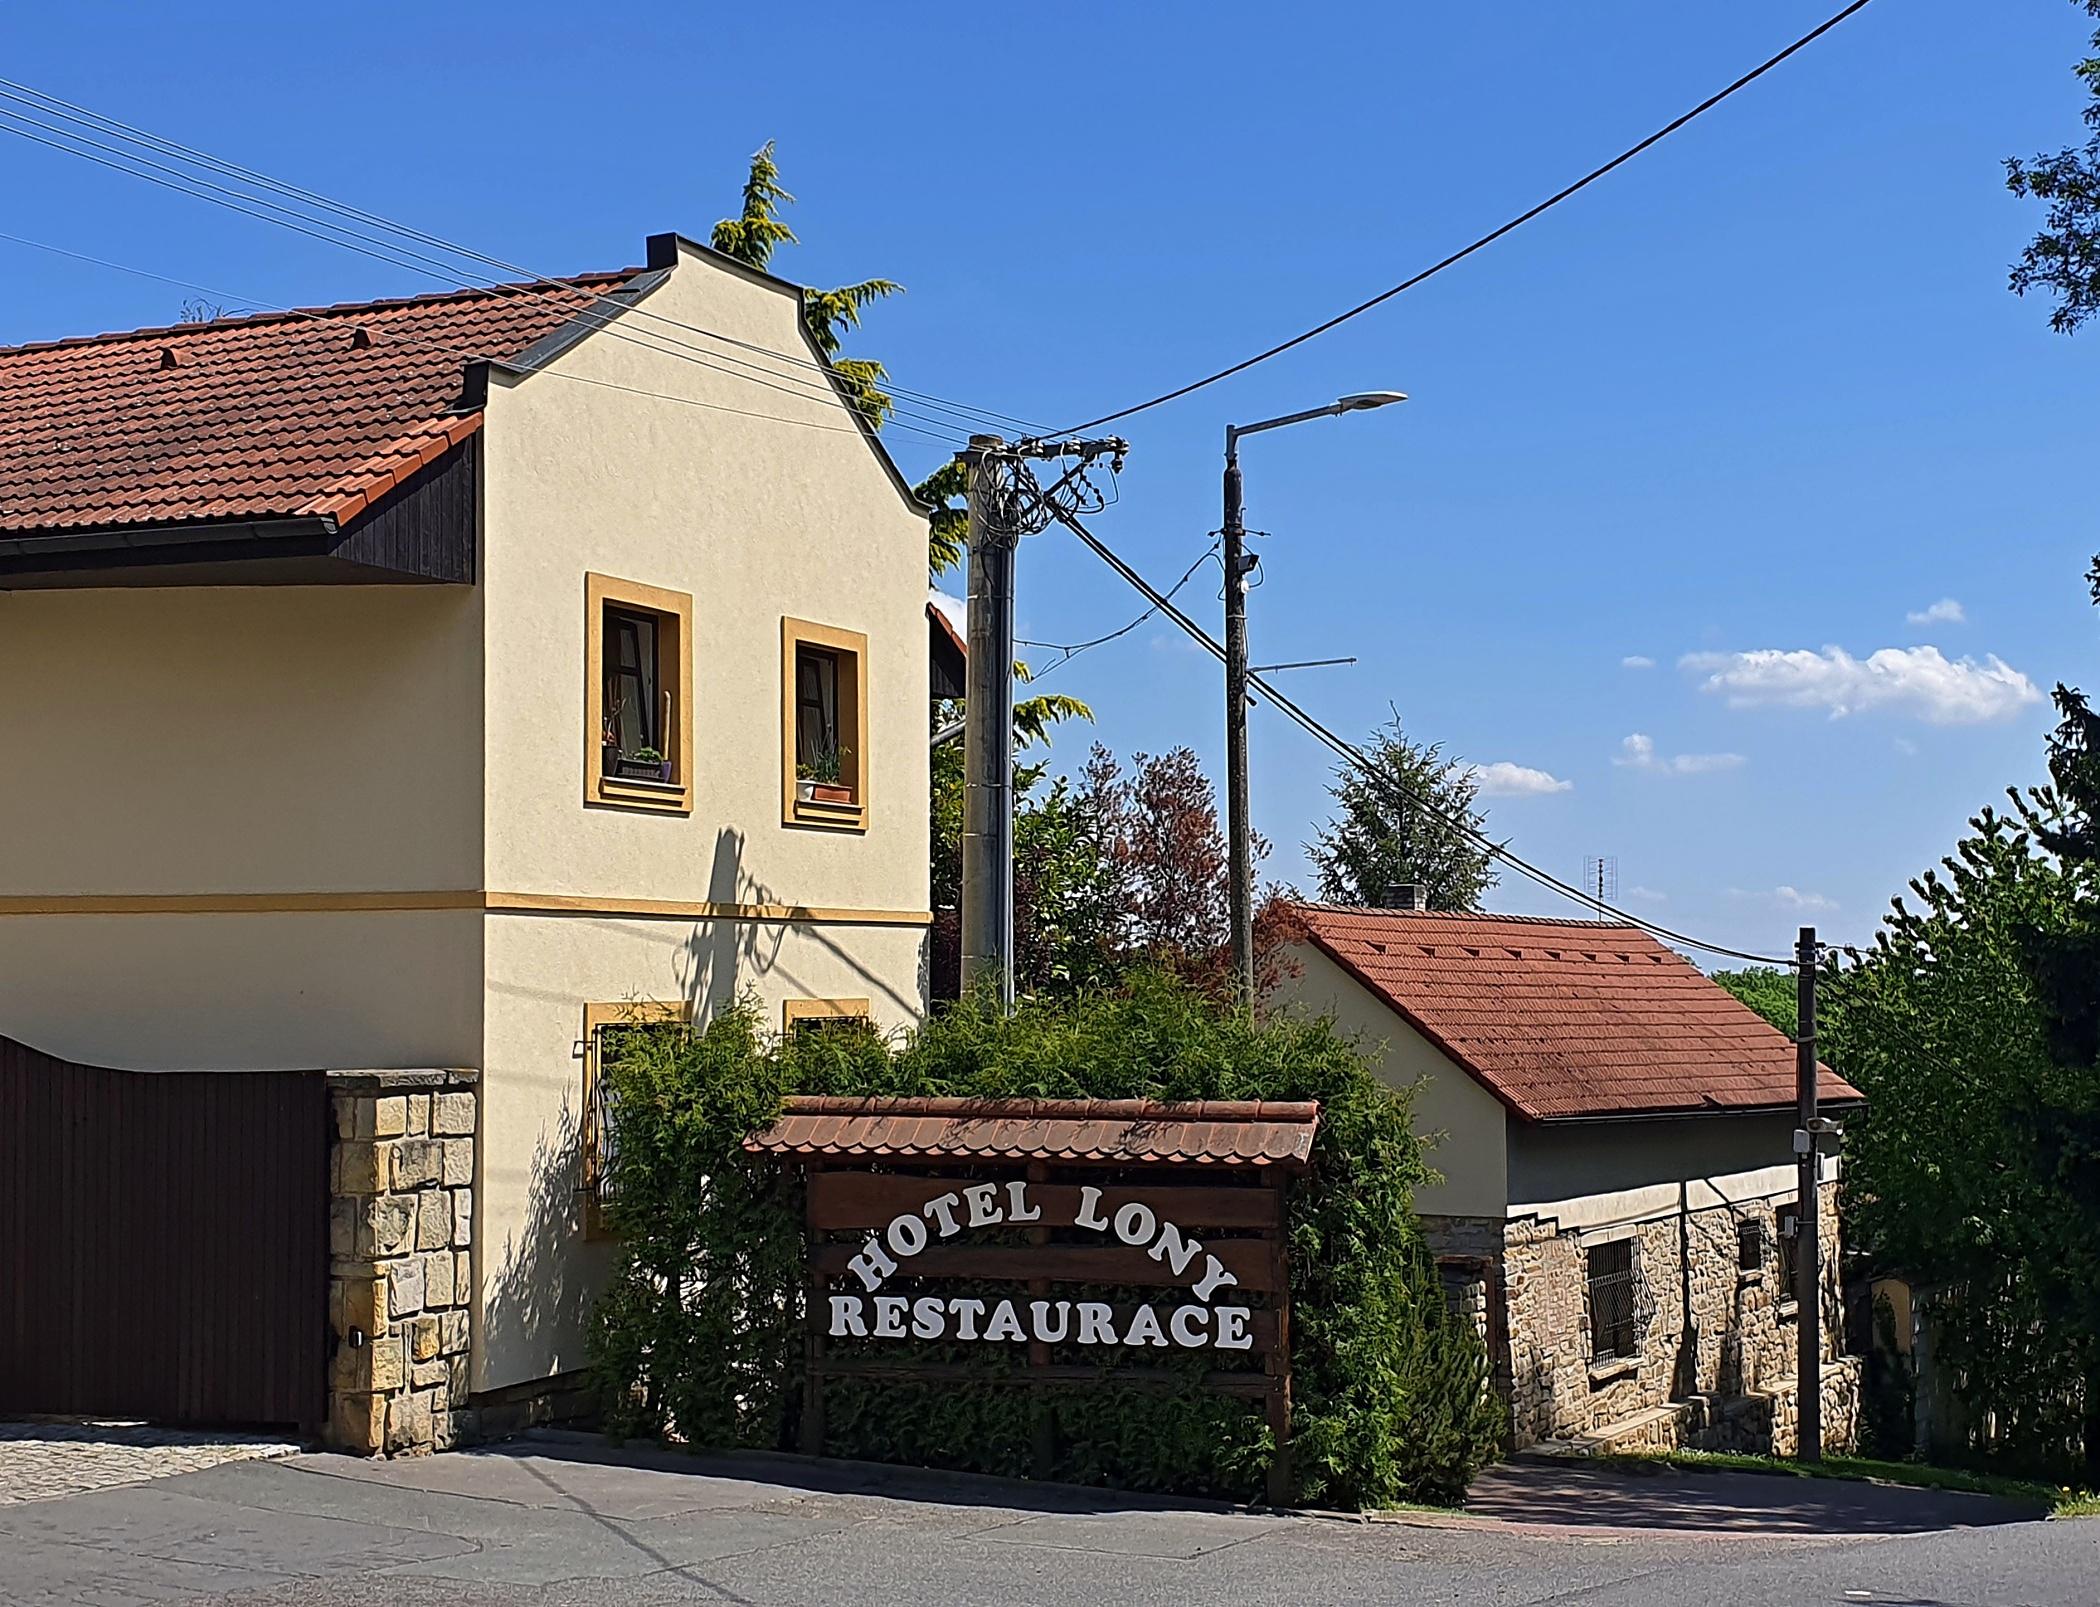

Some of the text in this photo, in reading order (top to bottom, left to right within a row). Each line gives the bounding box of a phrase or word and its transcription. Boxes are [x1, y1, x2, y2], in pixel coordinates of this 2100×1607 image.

[847, 1181, 1238, 1303] HOTEL LONY
[828, 1296, 1254, 1350] RESTAURACE
